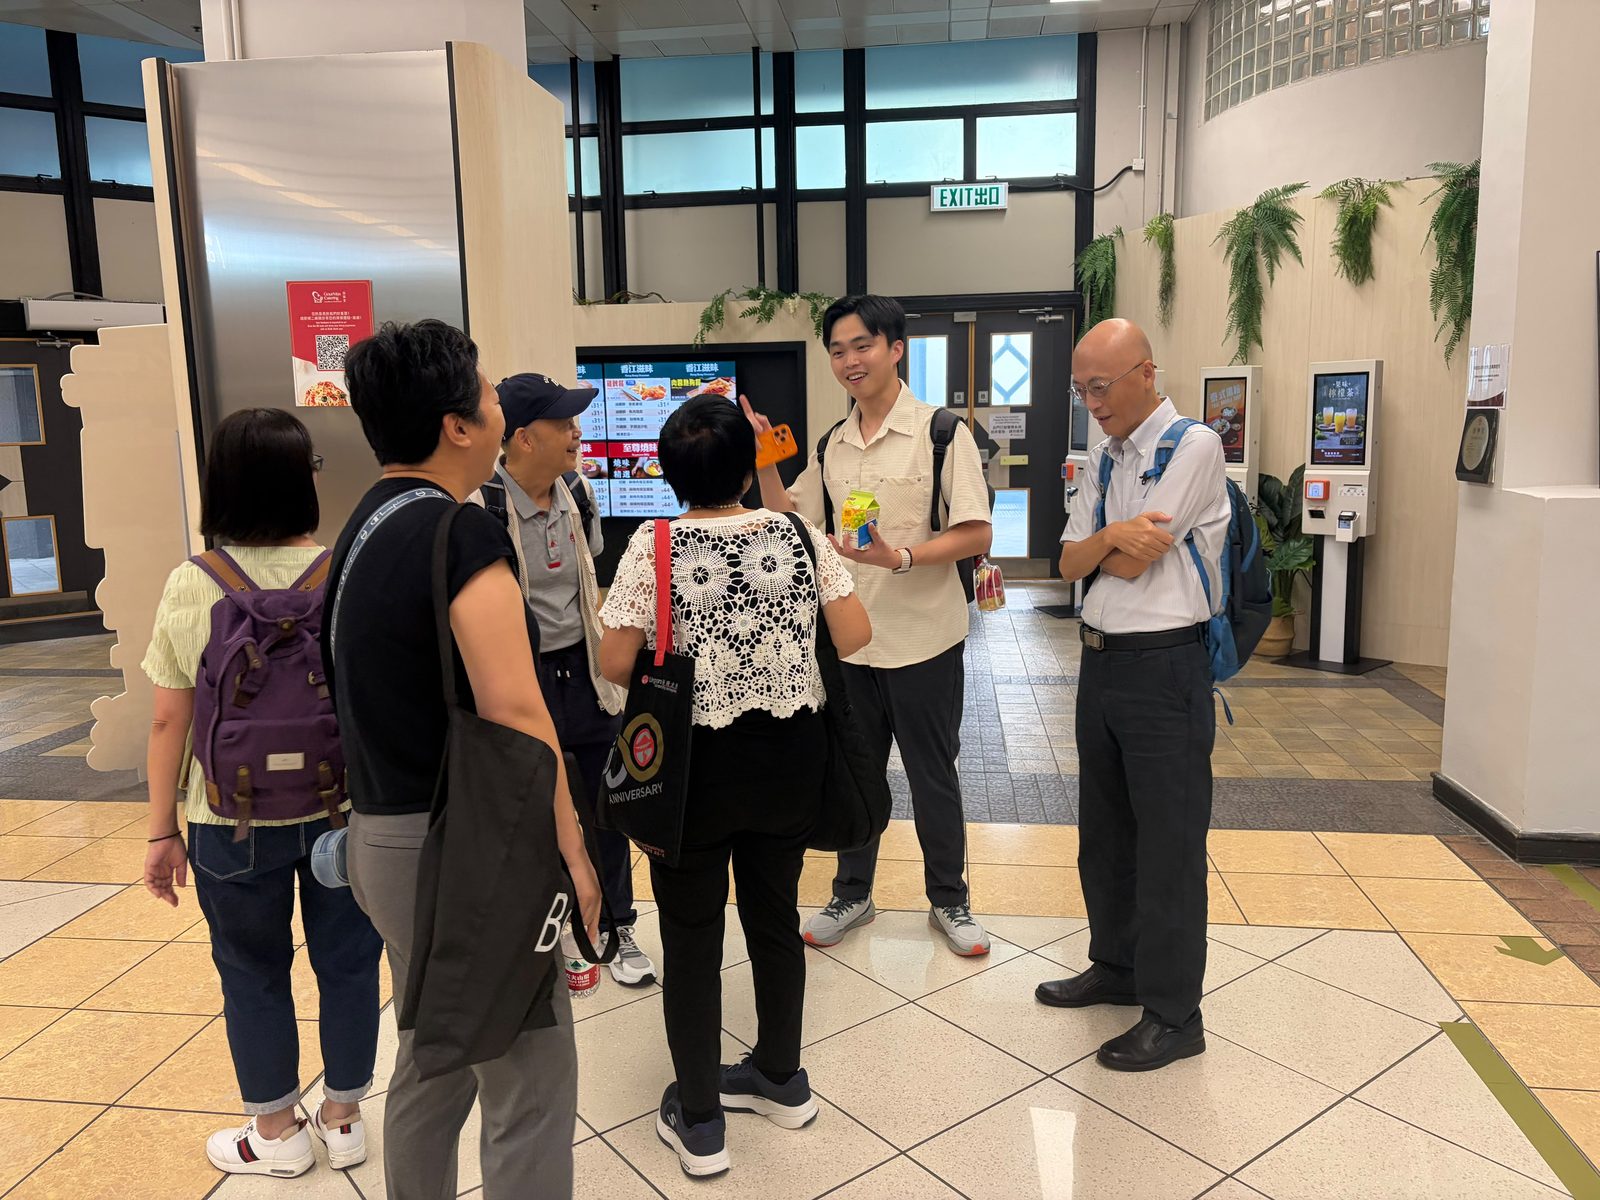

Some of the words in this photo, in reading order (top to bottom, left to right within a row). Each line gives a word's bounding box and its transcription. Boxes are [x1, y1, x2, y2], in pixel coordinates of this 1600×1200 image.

[940, 187, 973, 207] EXIT
[975, 187, 999, 206] 出口
[576, 364, 586, 375] 味
[620, 363, 654, 374] 香江滋味
[685, 362, 719, 373] 香江滋味
[623, 443, 658, 453] 至尊燒味
[608, 782, 664, 805] ANNIVERSARY
[534, 892, 572, 952] B
